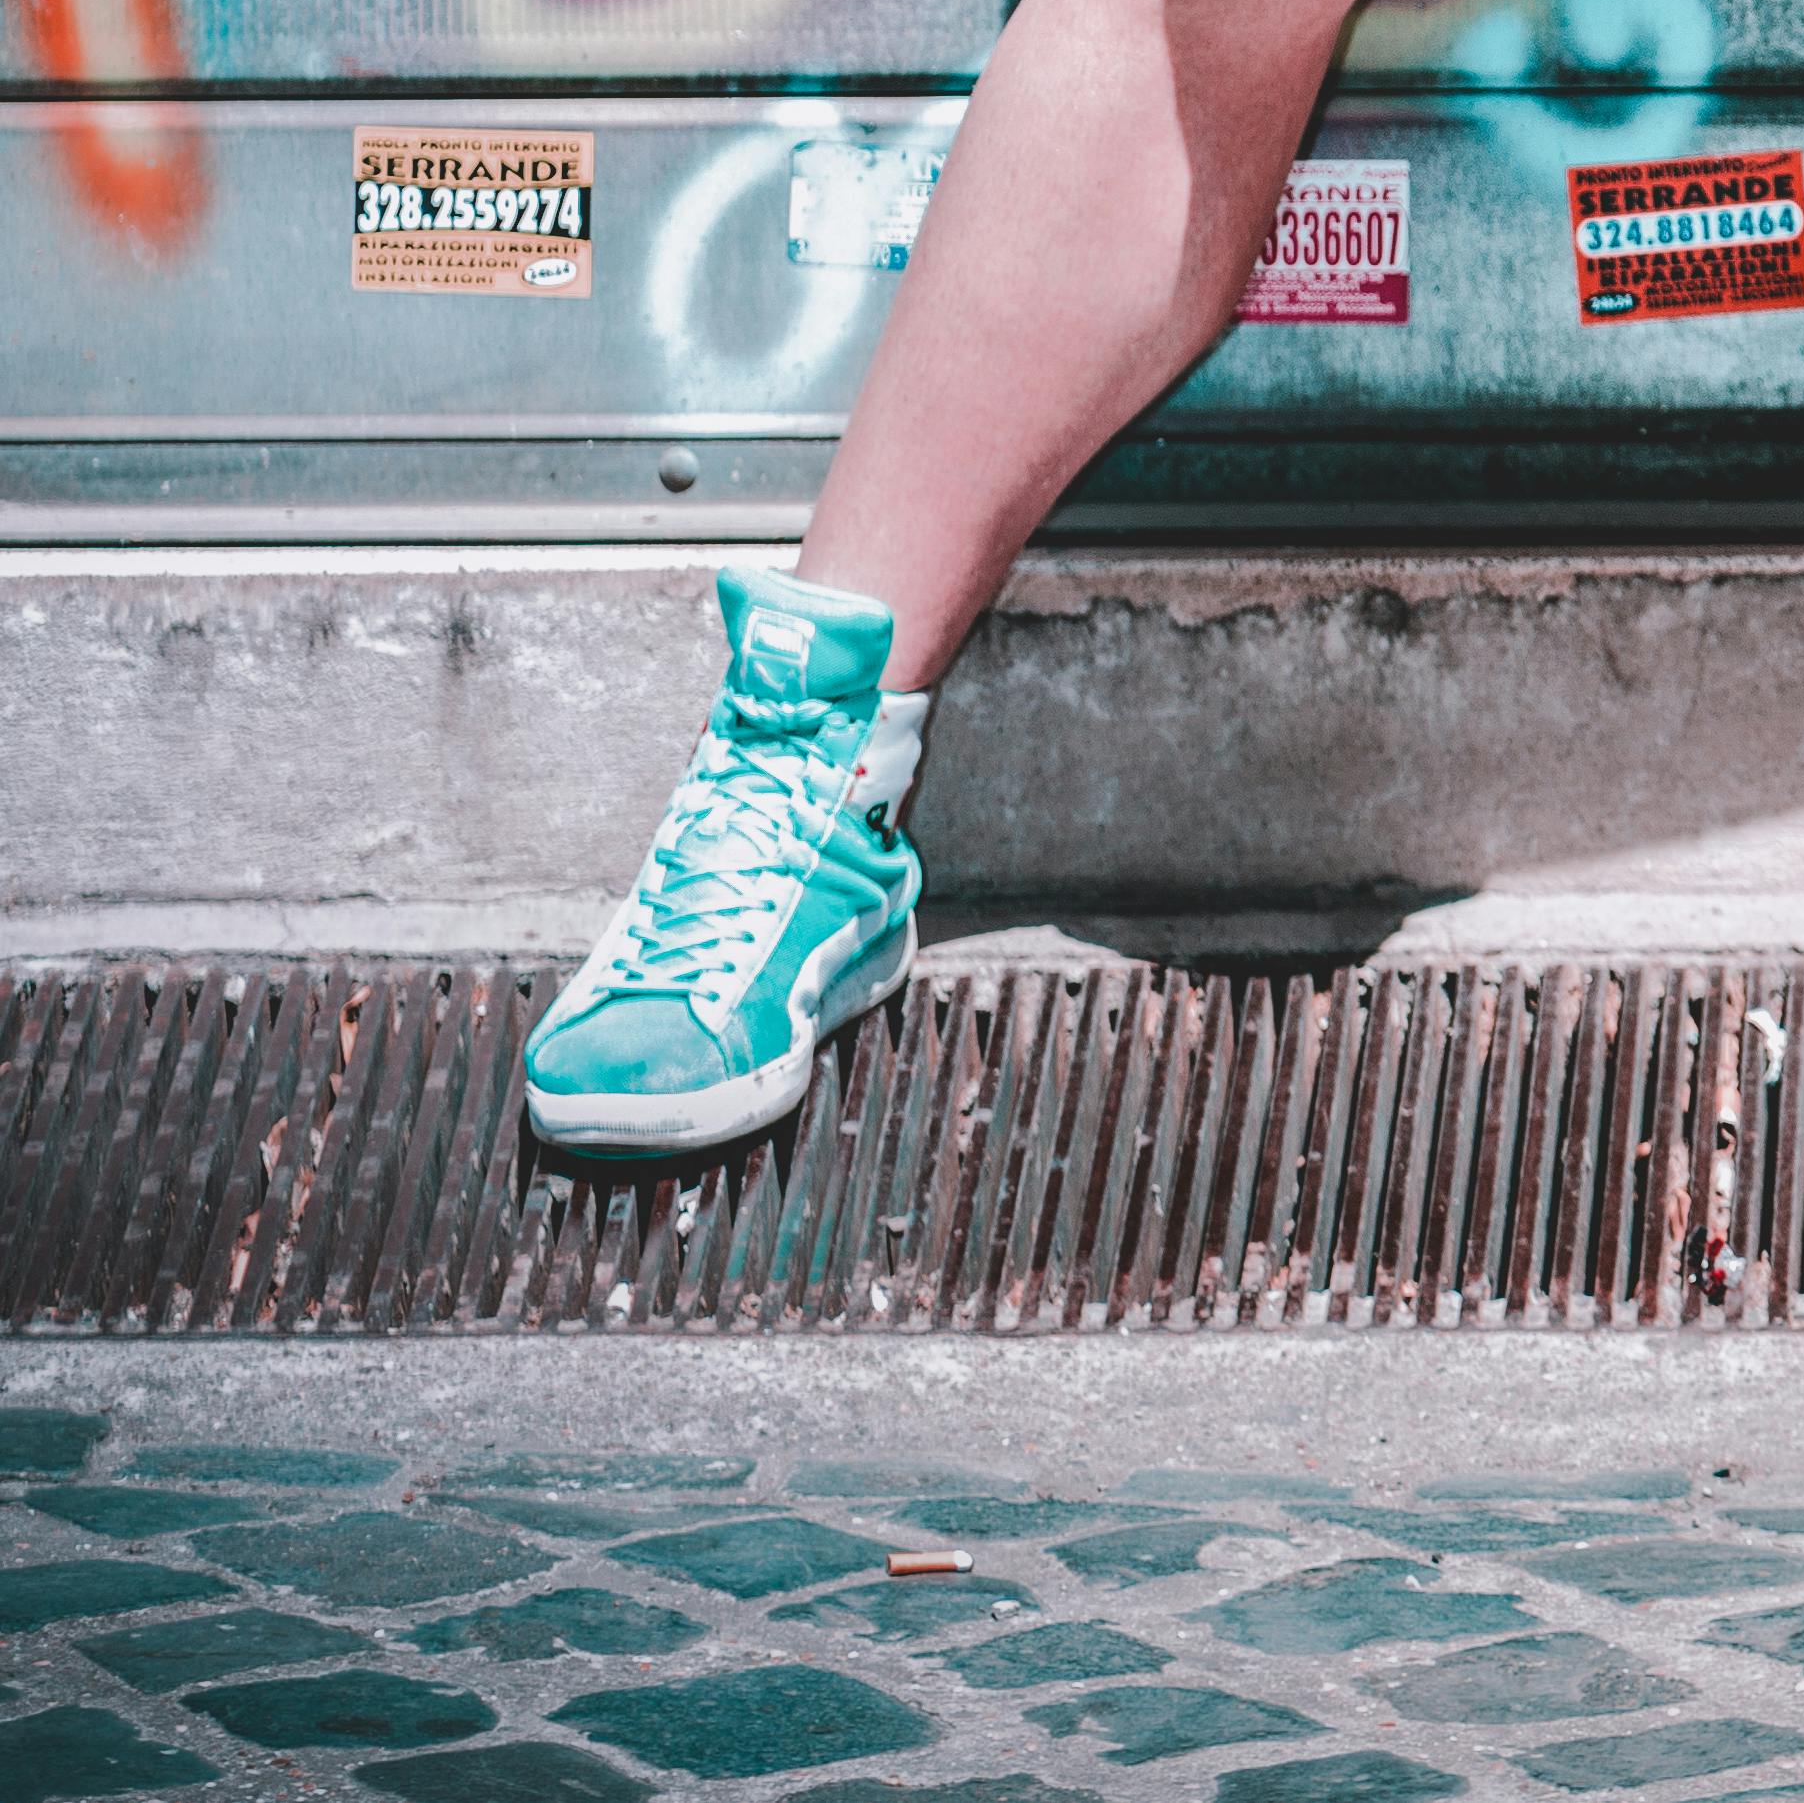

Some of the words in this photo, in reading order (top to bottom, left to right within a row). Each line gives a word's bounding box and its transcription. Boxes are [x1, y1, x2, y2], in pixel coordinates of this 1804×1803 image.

[420, 138, 482, 152] PRONTO
[489, 141, 580, 154] INTERVENTO
[362, 153, 580, 181] SERRANDE
[1576, 166, 1642, 186] PRONTO
[1648, 158, 1745, 180] INTERVENTO
[358, 180, 582, 237] 328.2559274
[1577, 174, 1795, 217] SERRANDE
[1585, 206, 1795, 251] 324.8818464
[359, 238, 485, 253] RIPARAZIONI
[494, 241, 578, 255] URGENTI
[1586, 243, 1800, 273] INSTALLAZIONI
[359, 256, 518, 269] MOTORIZZAZIONI
[1600, 257, 1791, 287] RIPARAZIONI
[359, 273, 494, 285] INSTALLAZIONI
